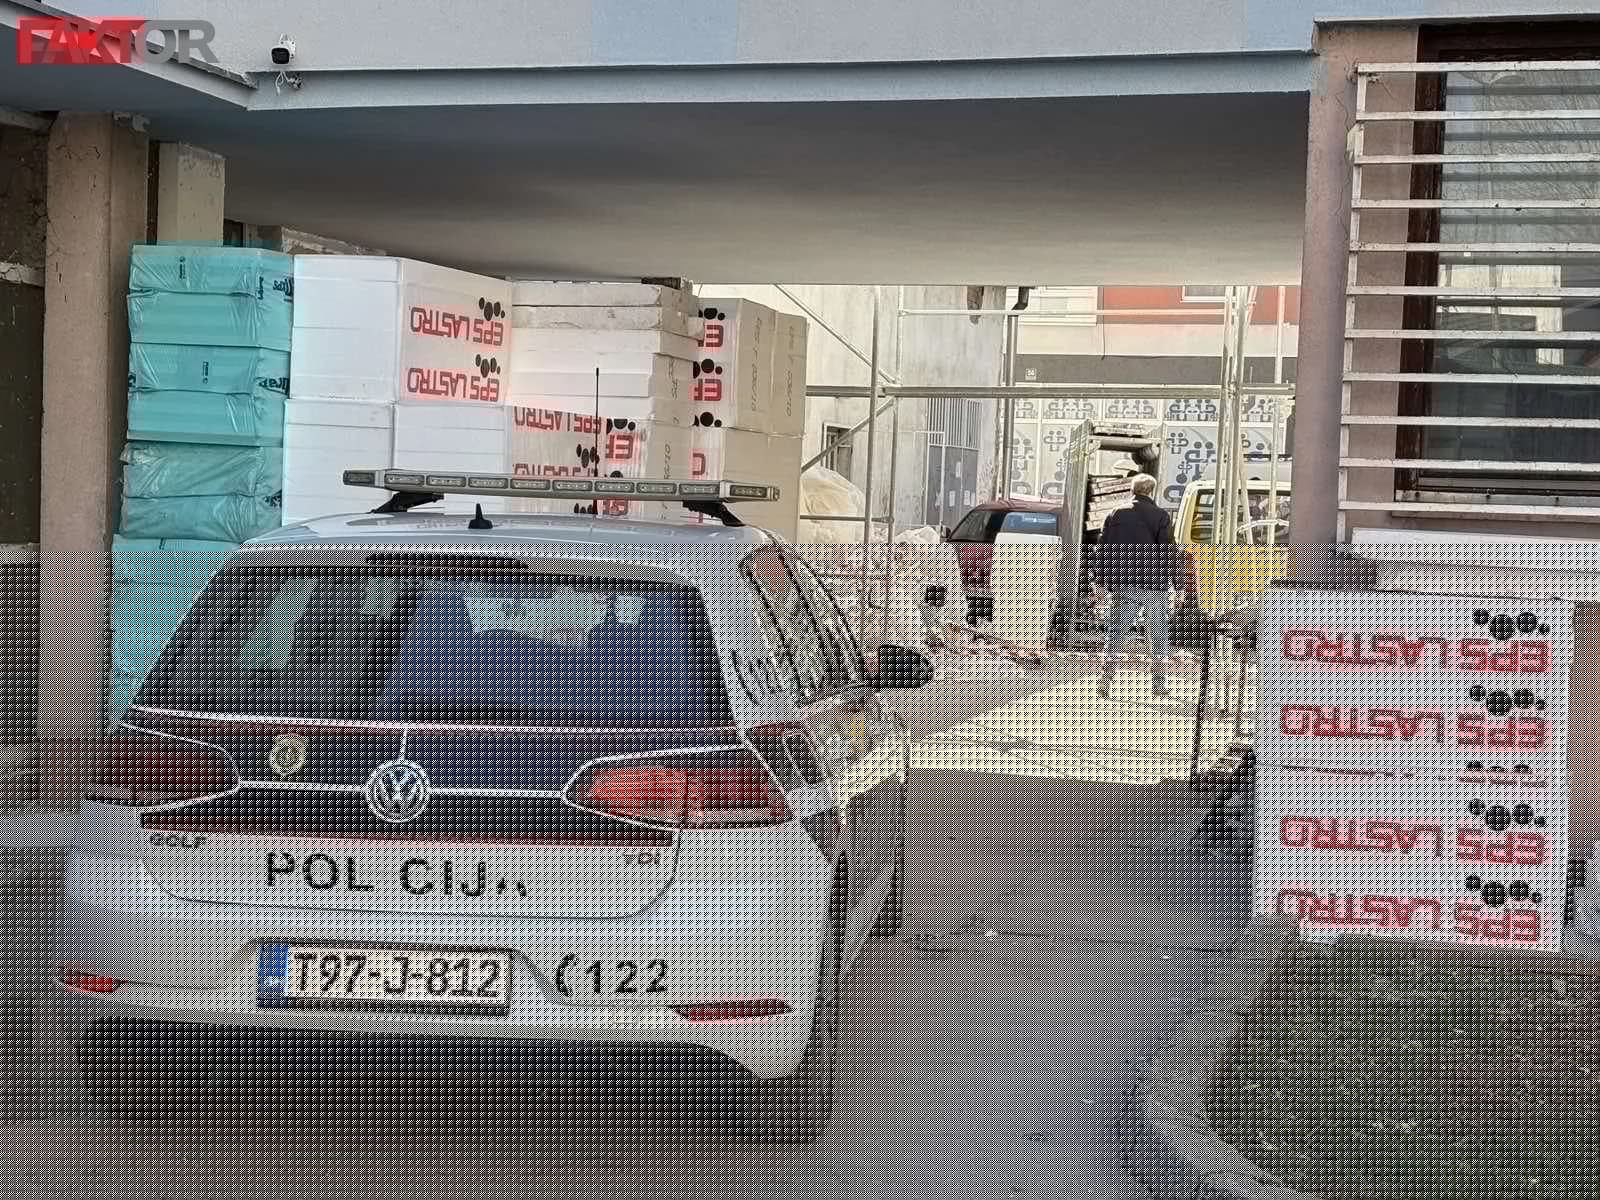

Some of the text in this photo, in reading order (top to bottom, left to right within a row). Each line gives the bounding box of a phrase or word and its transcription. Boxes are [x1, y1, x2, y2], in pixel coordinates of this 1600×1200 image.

[410, 306, 504, 347] EPS LASTRO
[406, 367, 500, 403] EPS LASTRO
[1282, 630, 1549, 673] EPS LASTRO
[1280, 705, 1547, 749] EPS LASTRO
[149, 833, 207, 849] GOLF
[1280, 815, 1546, 866] EPS LASTRO
[1454, 902, 1541, 943] EPS
[294, 953, 500, 998] T97-J-812
[586, 958, 669, 995] 122
